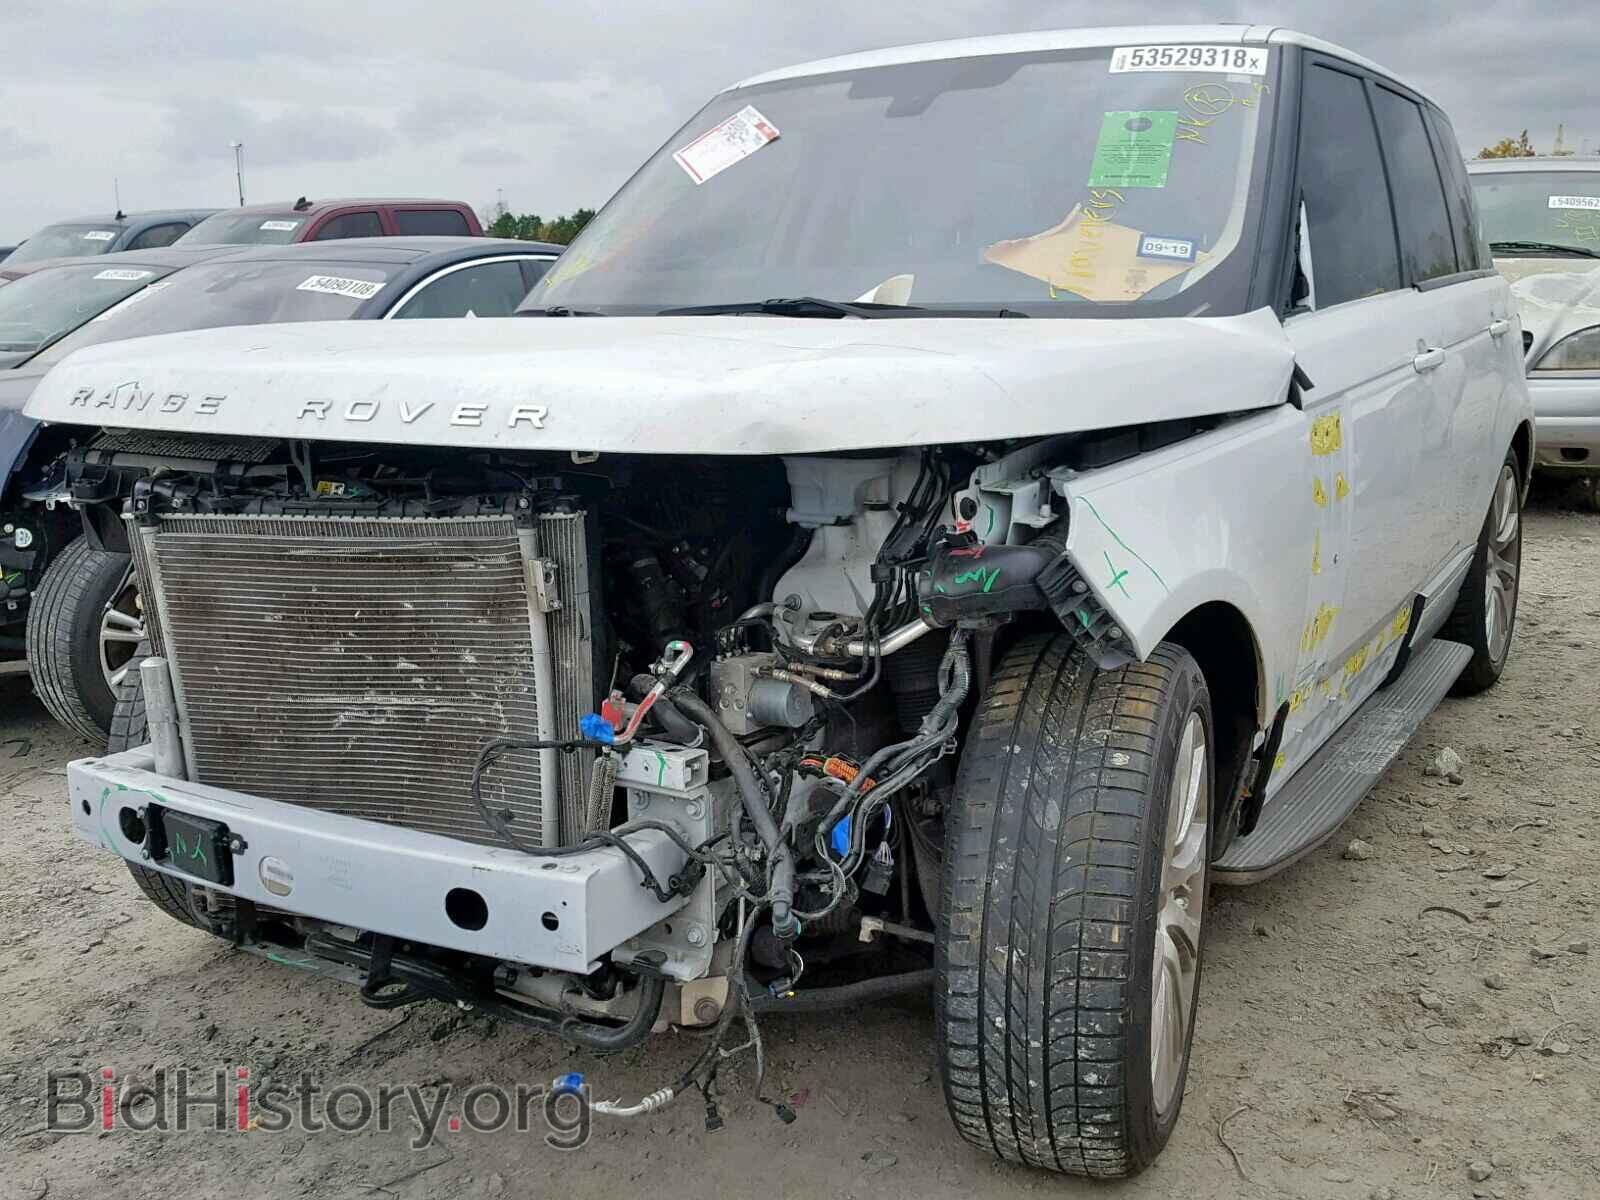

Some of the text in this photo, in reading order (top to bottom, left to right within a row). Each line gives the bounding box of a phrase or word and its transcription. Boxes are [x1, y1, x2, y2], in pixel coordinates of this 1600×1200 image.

[1130, 47, 1247, 68] 53529318
[68, 385, 550, 430] RANGE ROVER
